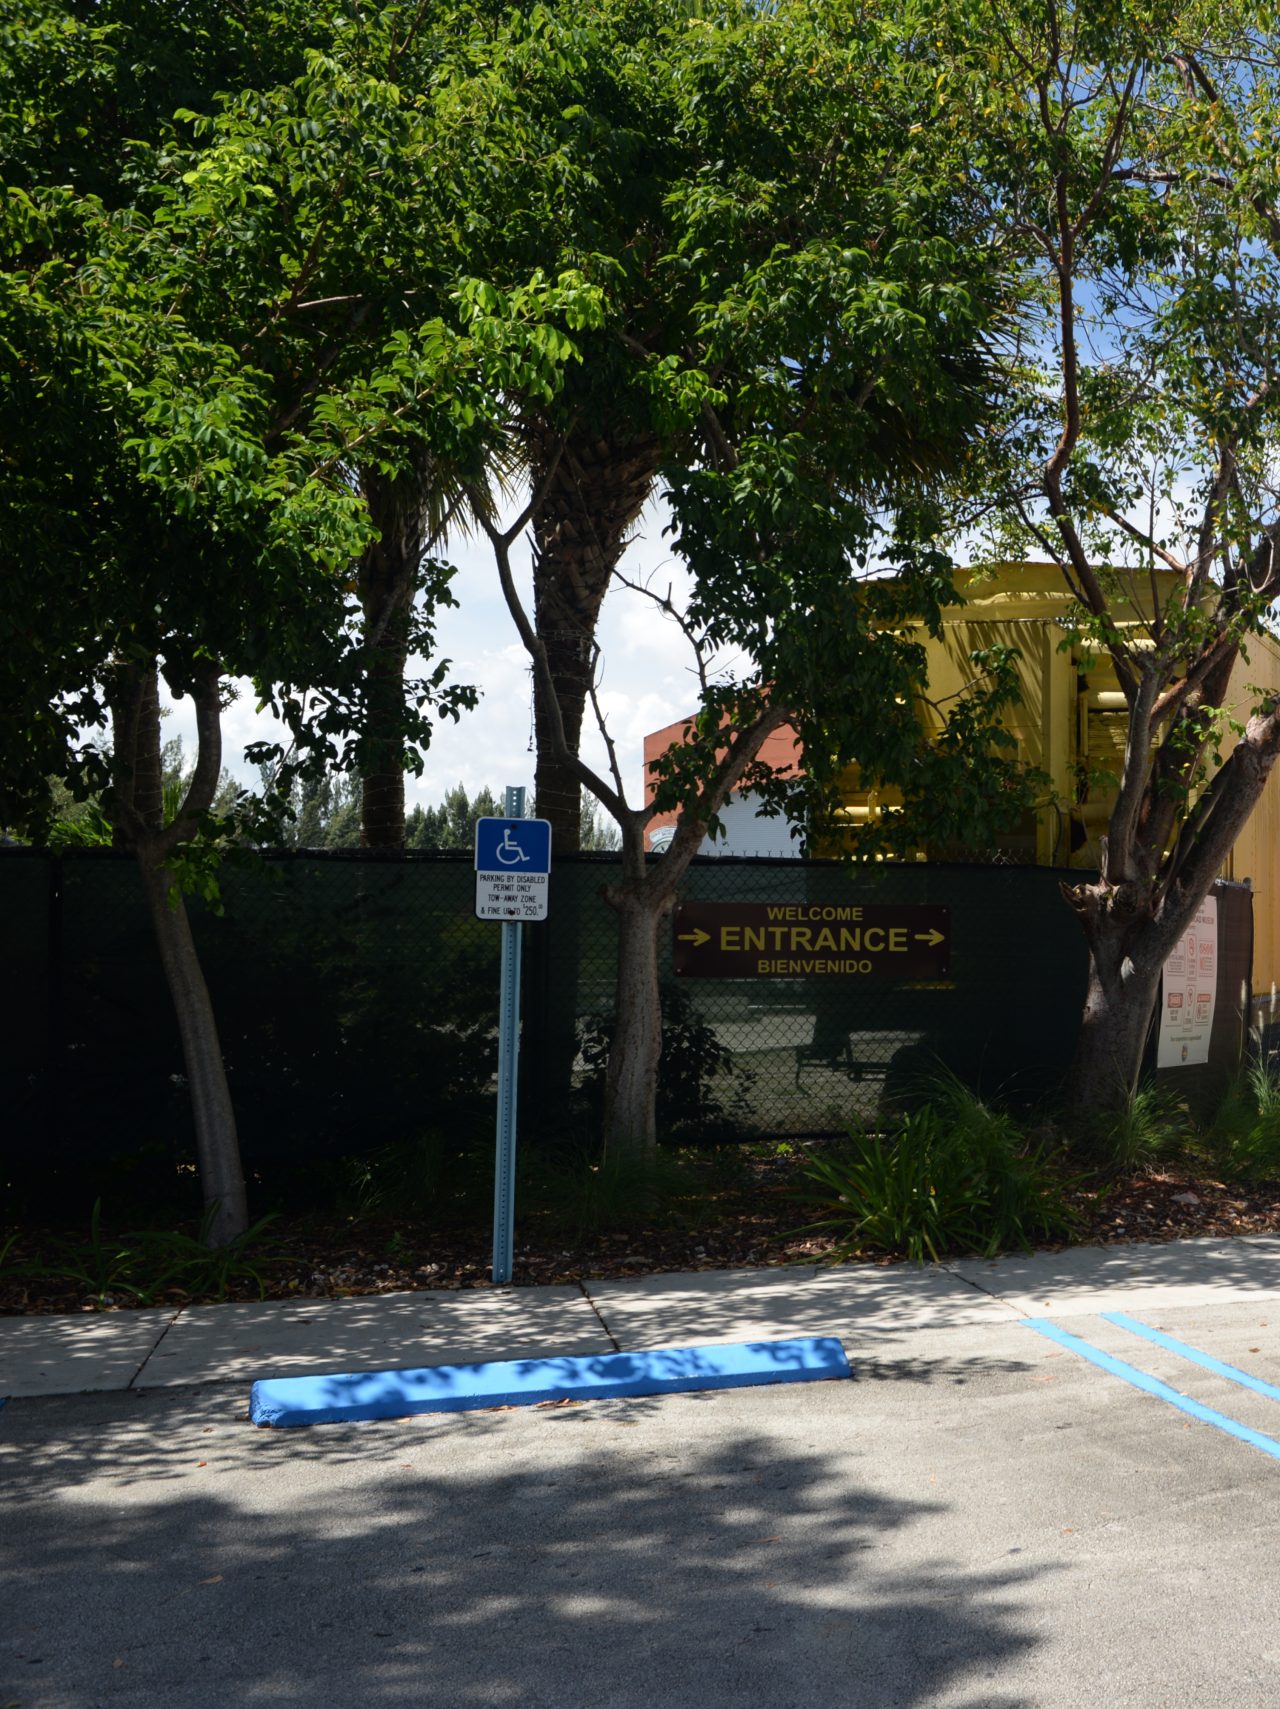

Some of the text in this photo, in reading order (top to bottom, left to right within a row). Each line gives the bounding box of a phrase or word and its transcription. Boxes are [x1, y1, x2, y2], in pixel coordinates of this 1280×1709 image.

[479, 874, 546, 884] PARKING BY DISABLED
[493, 884, 532, 893] PERMIT ONLY
[520, 895, 536, 904] ZONE
[487, 907, 501, 915] FINE
[767, 906, 864, 922] WELCOME
[720, 926, 909, 952] ENTRANCE
[757, 959, 873, 974] BIENVENIDO
